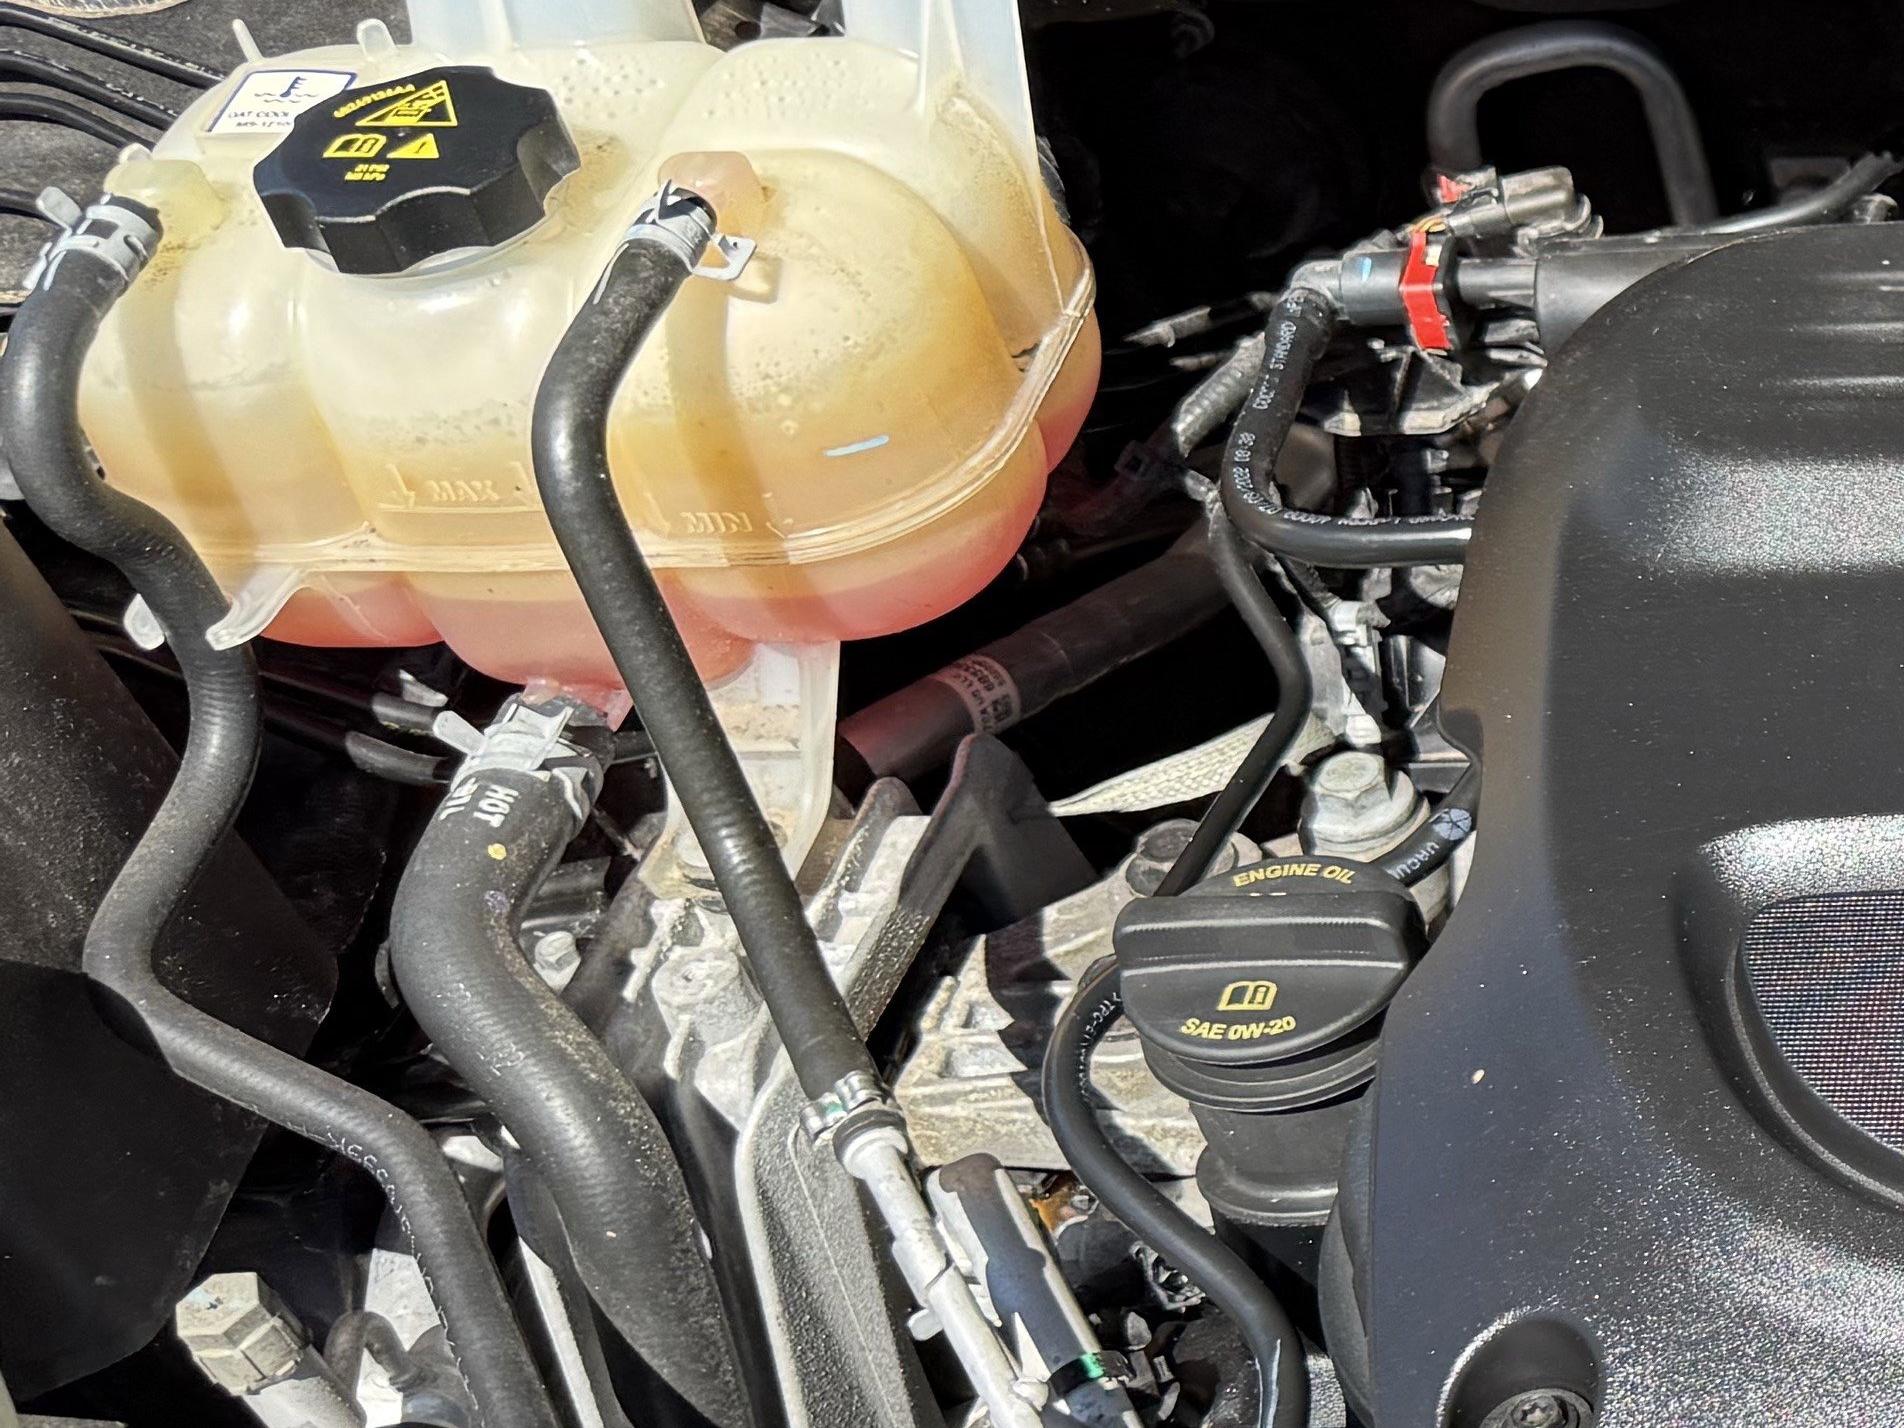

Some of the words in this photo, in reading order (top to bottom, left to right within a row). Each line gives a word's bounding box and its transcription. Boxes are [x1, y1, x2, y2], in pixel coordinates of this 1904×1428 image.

[426, 479, 501, 501] MAX
[679, 511, 753, 535] MIN
[473, 784, 519, 828] HOT
[1232, 863, 1321, 888] ENGINE
[1322, 866, 1356, 885] OIL
[1180, 1016, 1227, 1041] SAE
[1227, 1014, 1297, 1039] 0W-20
